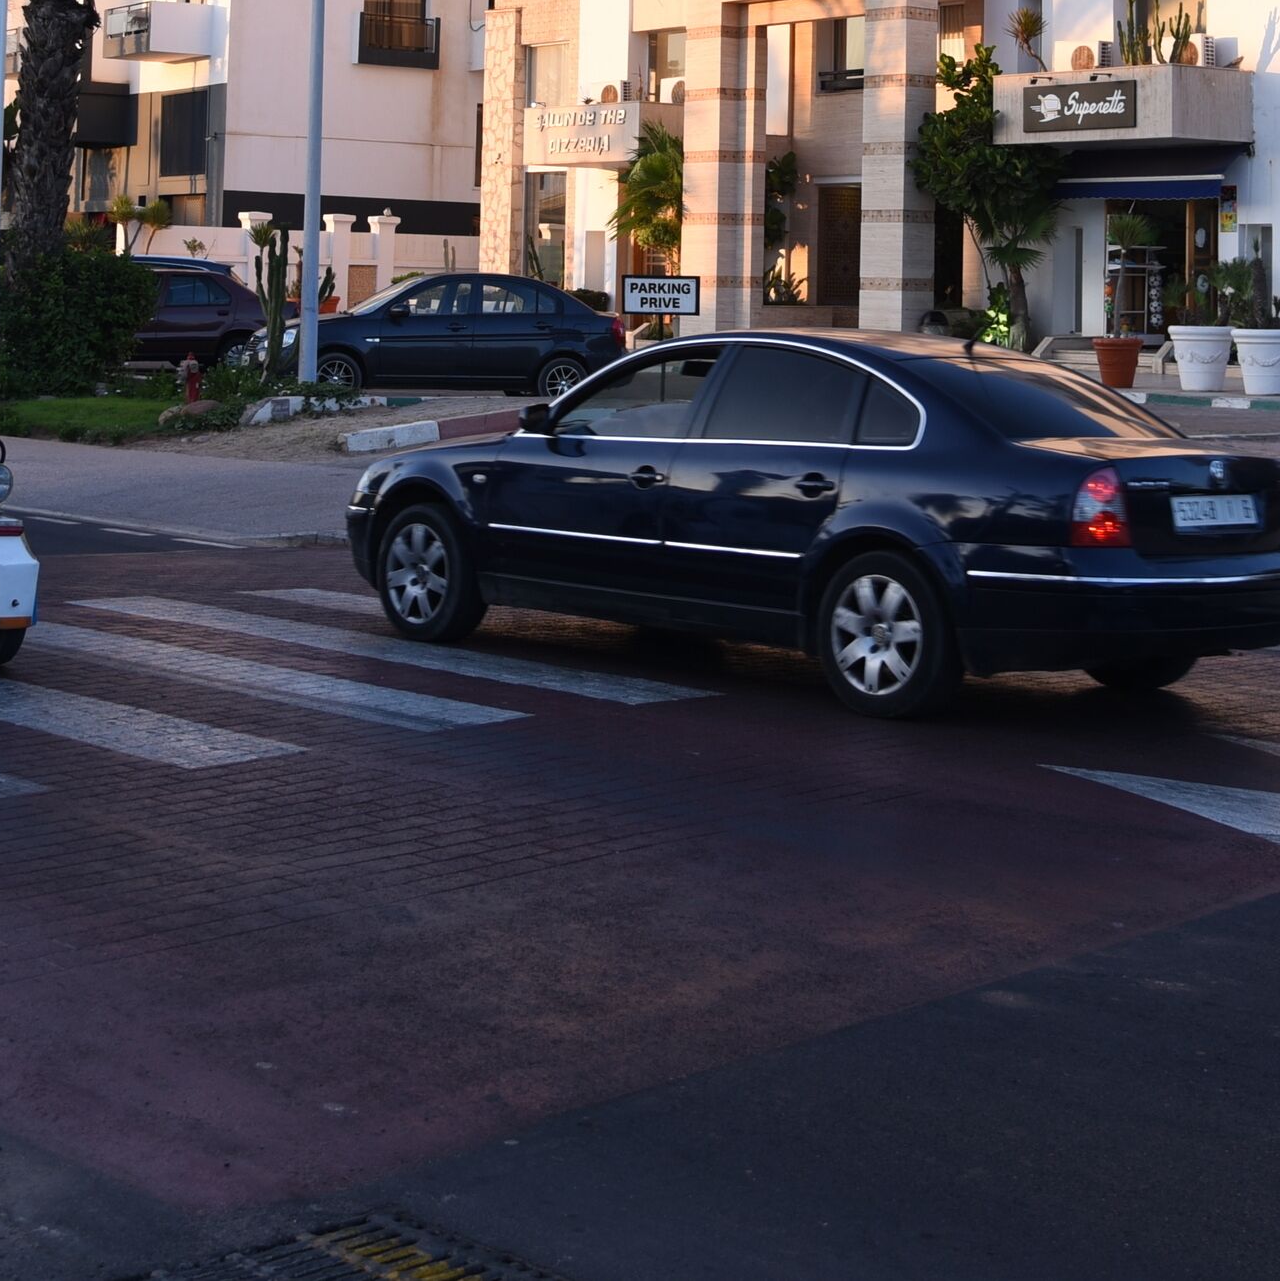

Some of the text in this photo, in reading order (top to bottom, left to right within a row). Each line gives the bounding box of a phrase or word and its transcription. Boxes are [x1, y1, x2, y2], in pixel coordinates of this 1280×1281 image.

[1064, 89, 1126, 125] Superette
[630, 283, 691, 294] PARKING
[640, 297, 680, 308] PRIVE
